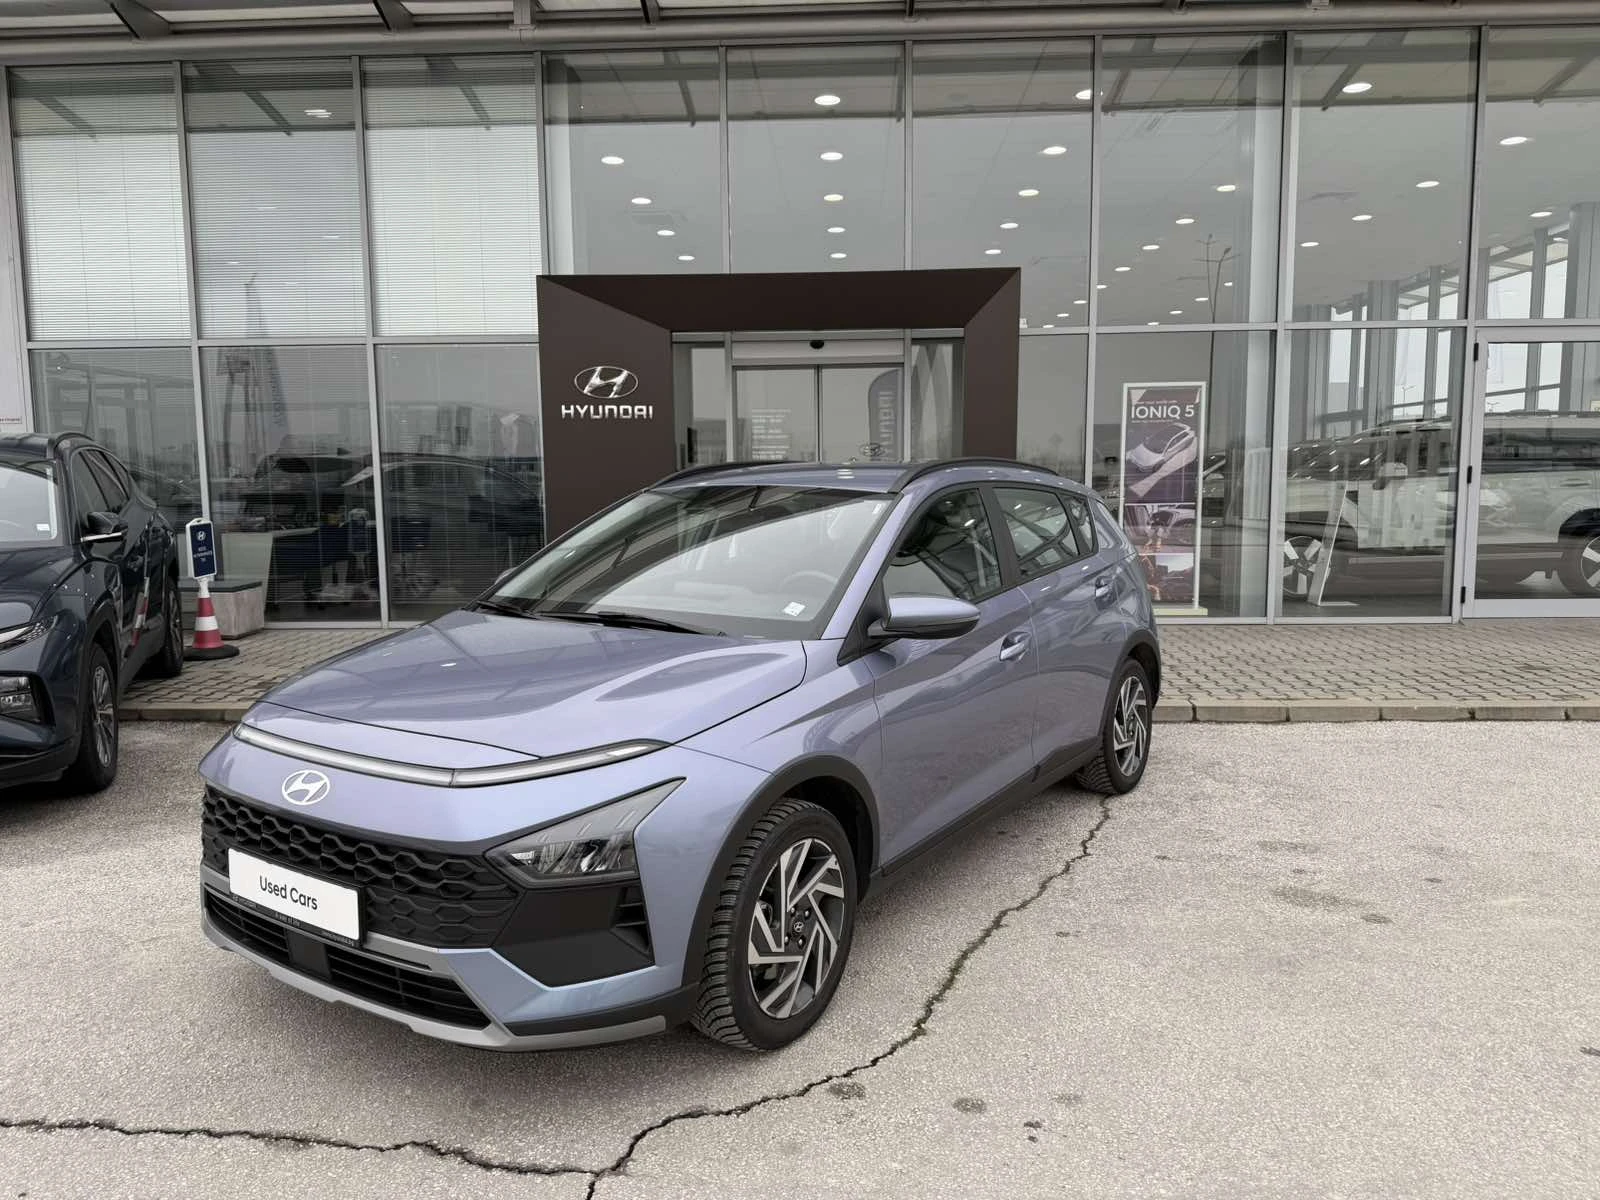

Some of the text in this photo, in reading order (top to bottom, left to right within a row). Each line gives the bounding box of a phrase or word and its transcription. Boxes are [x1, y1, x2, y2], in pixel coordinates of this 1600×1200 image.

[561, 404, 653, 419] HYUNDAI
[1131, 404, 1195, 420] IONIQ 5
[259, 874, 318, 911] Used Cars
